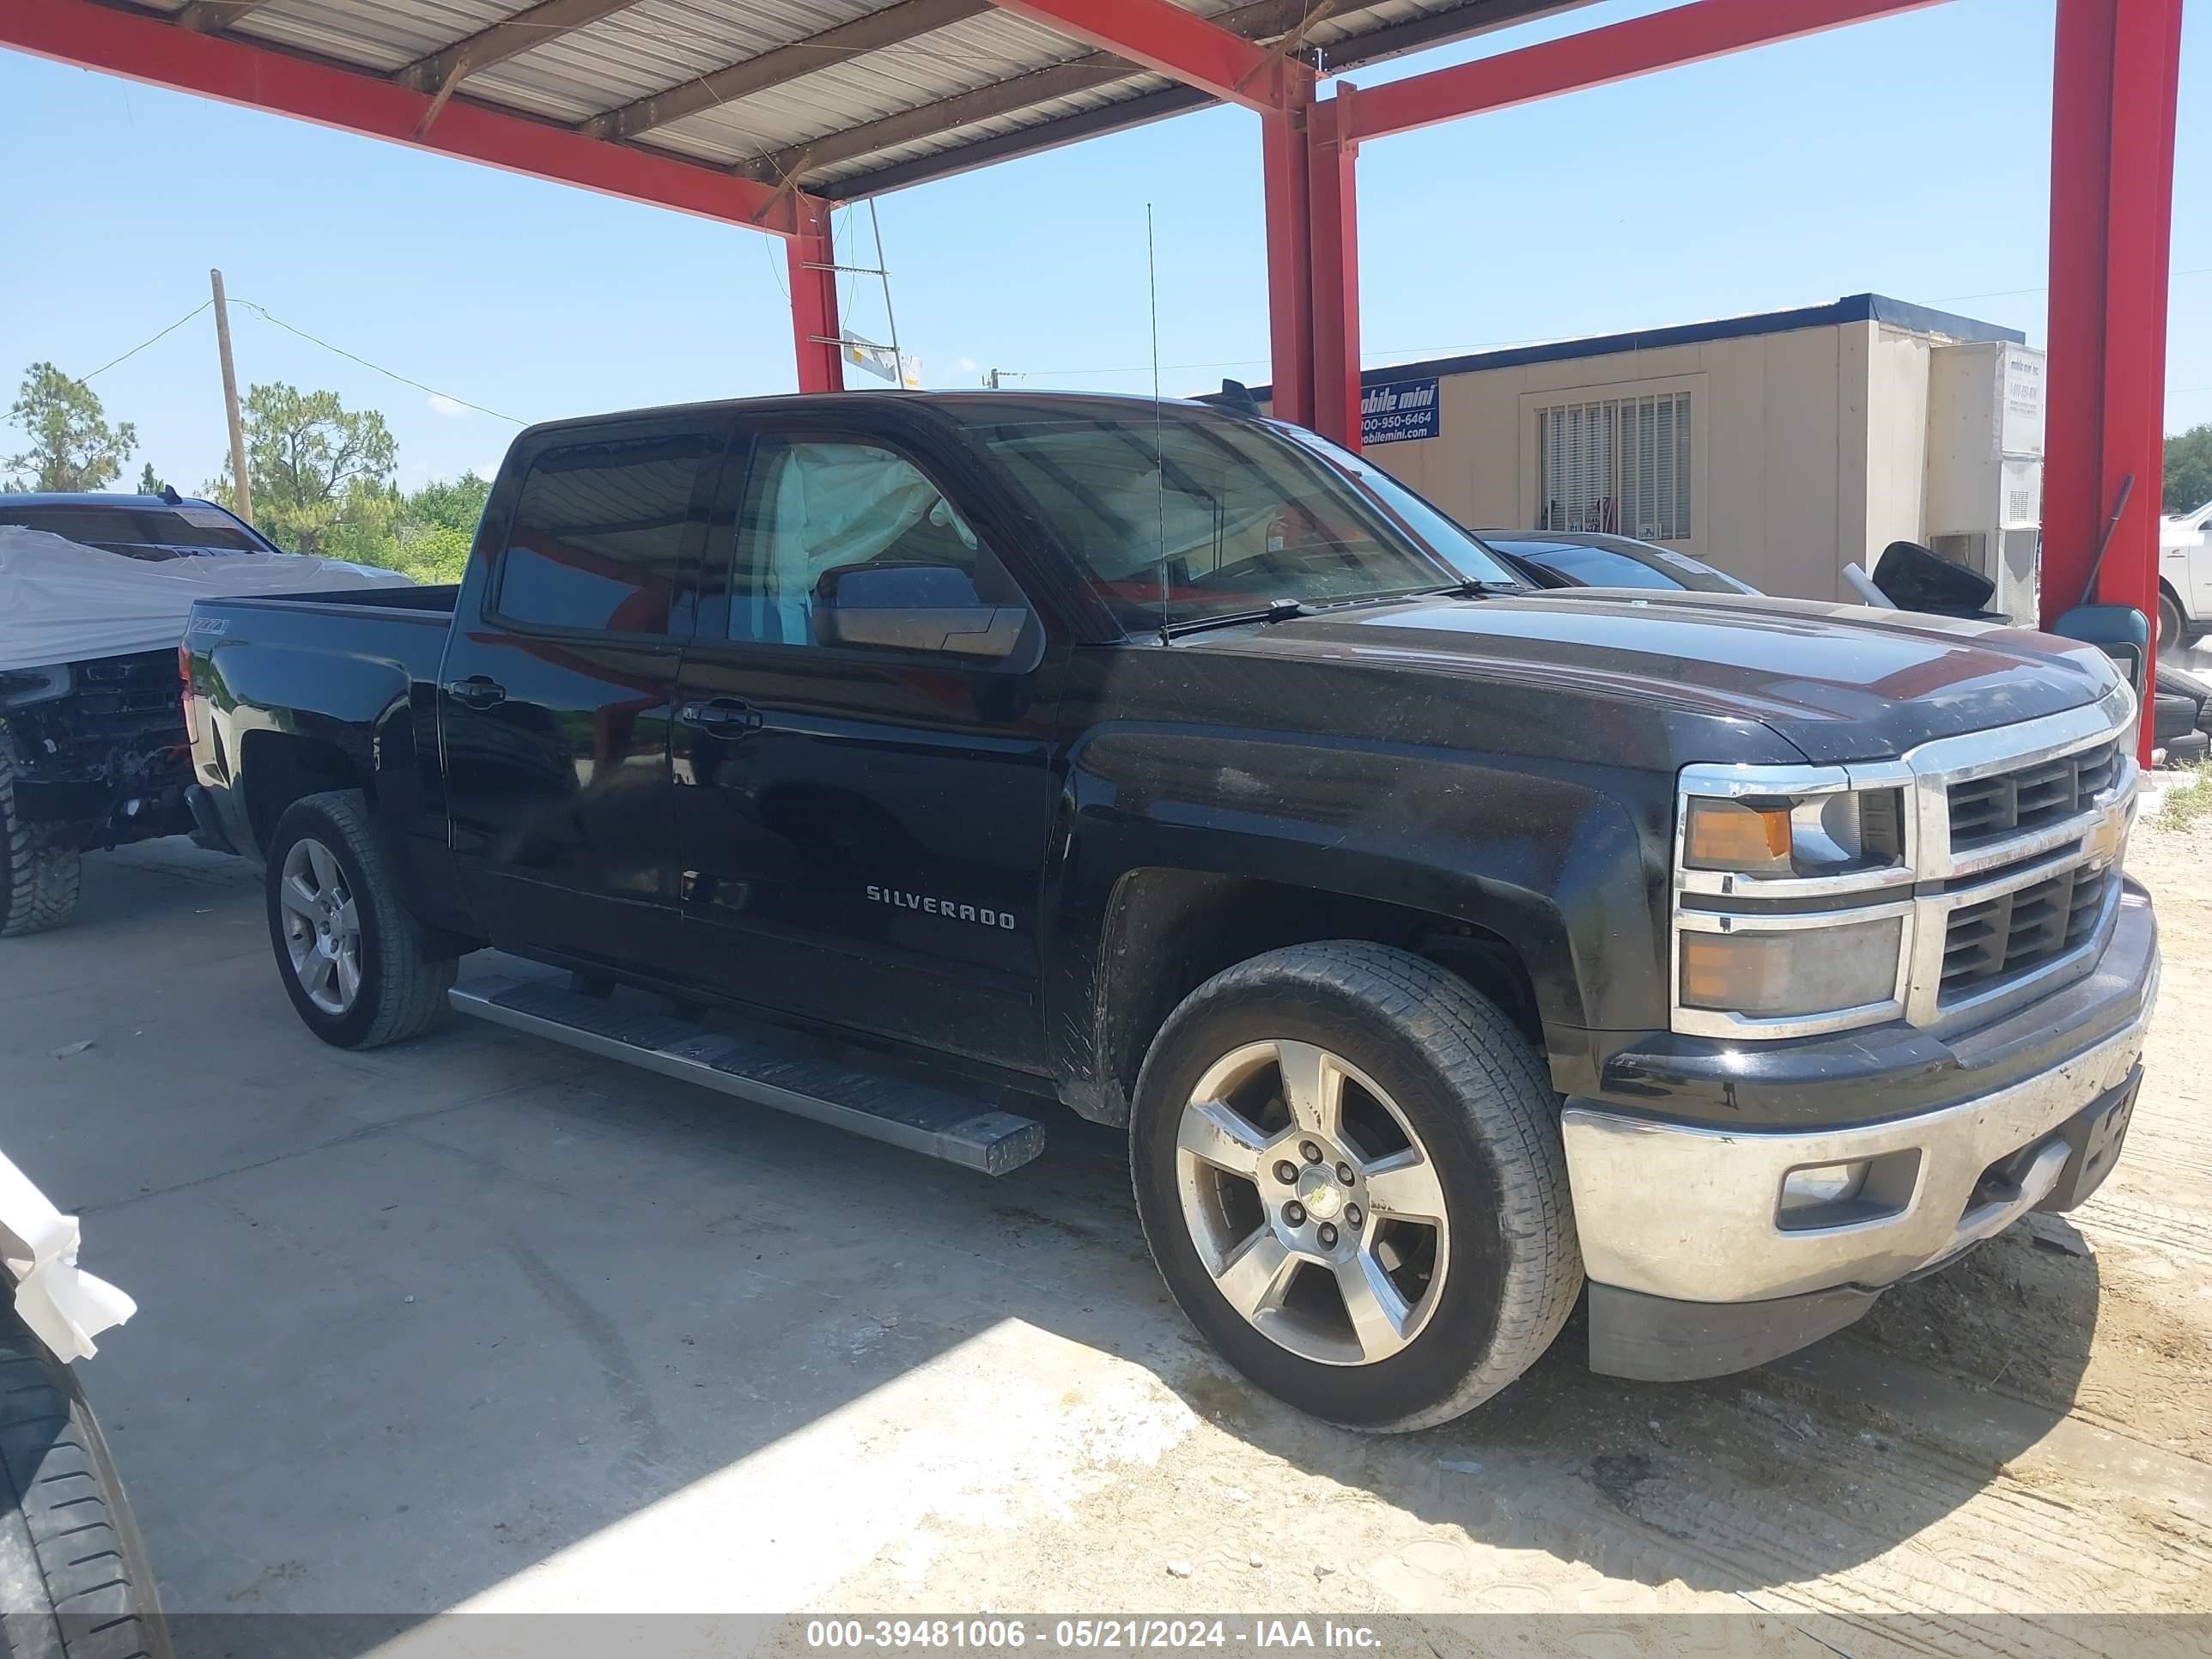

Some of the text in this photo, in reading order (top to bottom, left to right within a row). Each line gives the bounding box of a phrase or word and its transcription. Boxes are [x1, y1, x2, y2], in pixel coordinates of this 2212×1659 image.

[1398, 384, 1436, 410] mini
[1361, 428, 1428, 444] obilemini.com
[866, 885, 1015, 930] SILVERADO
